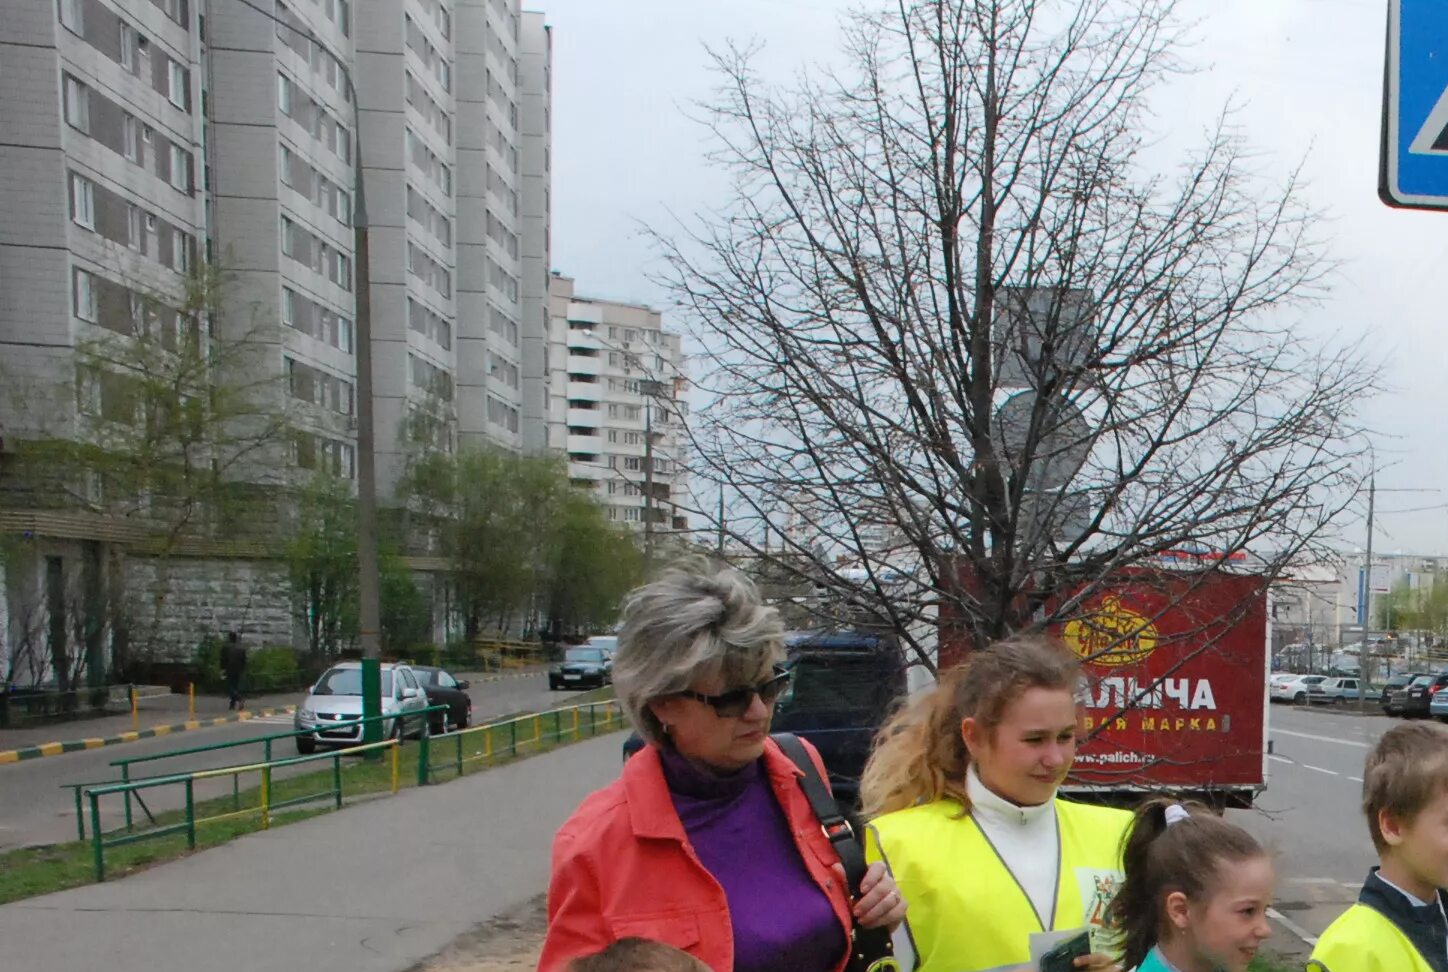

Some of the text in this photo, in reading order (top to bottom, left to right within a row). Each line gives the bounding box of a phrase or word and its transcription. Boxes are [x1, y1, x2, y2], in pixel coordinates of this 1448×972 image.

[1074, 676, 1217, 711] АЛЫЧА
[1141, 717, 1217, 731] МАРКА
[1074, 751, 1156, 766] ww.palich.ru
